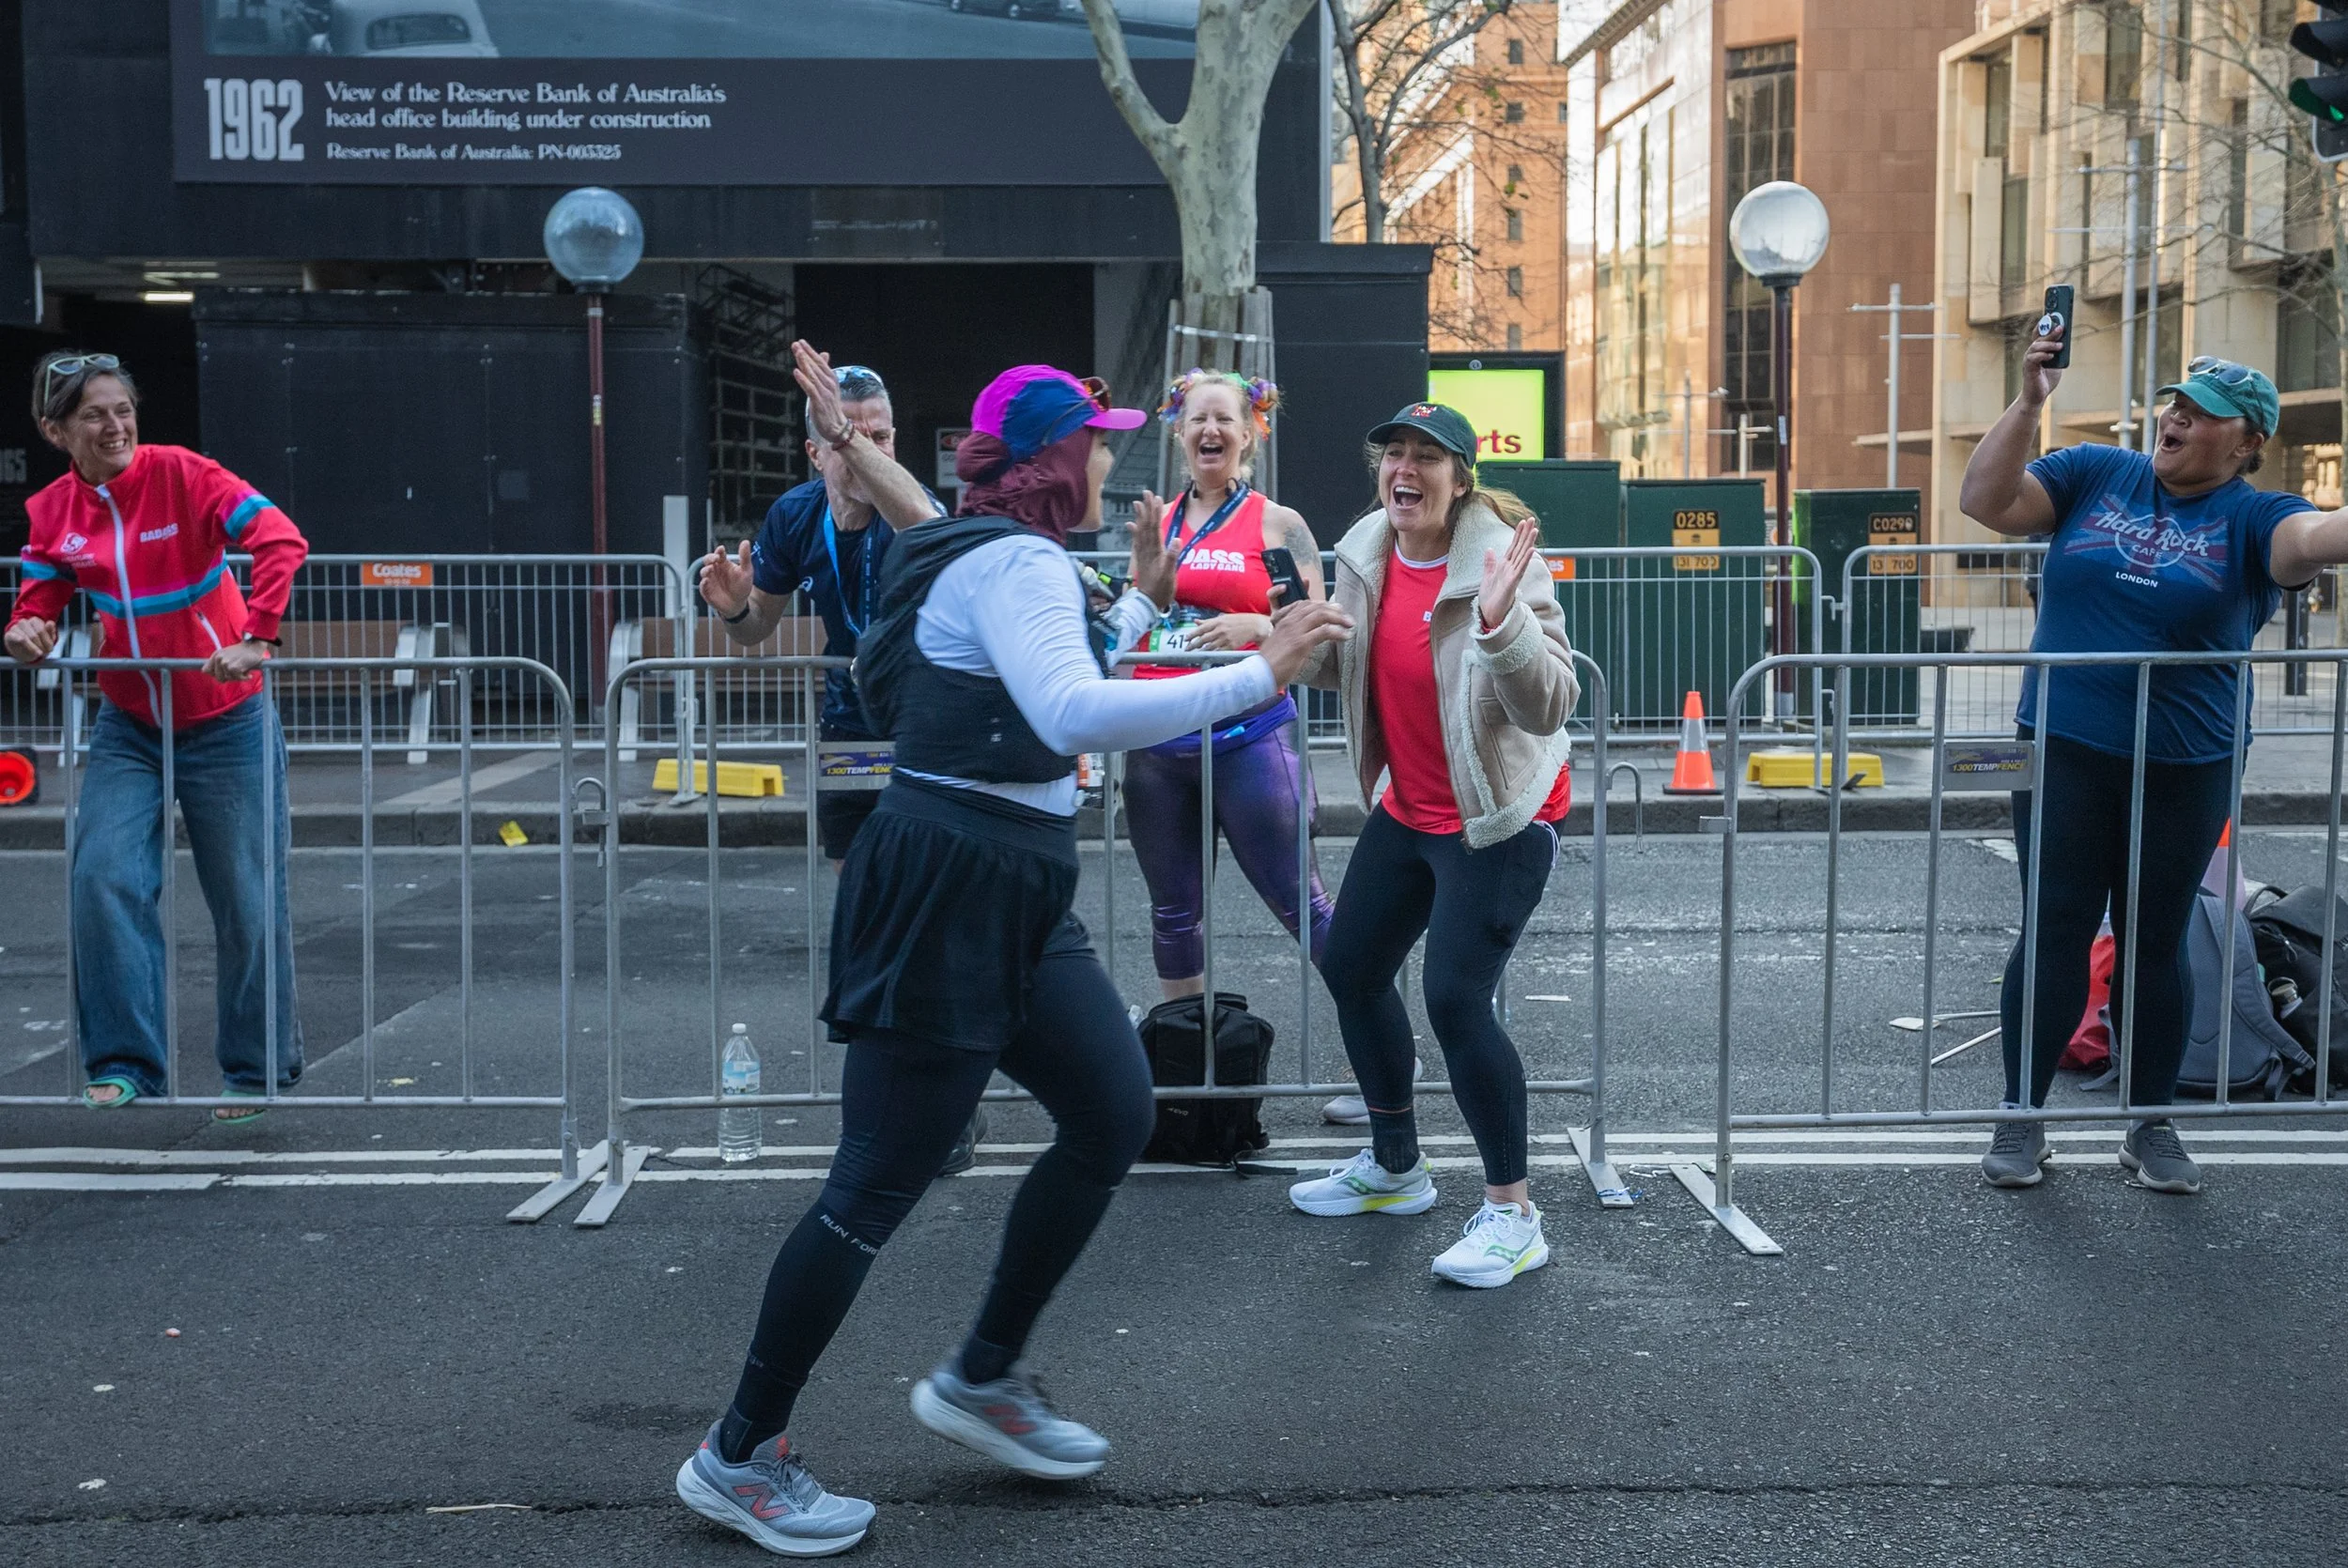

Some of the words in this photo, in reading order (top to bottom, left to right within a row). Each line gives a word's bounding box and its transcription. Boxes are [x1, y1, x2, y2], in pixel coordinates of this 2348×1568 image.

[324, 81, 376, 102] View
[381, 82, 403, 103] of
[408, 82, 440, 103] the
[447, 82, 531, 104] Reserve
[536, 83, 592, 103] Bank
[596, 83, 619, 103] of
[623, 83, 727, 104] Australia's
[204, 78, 304, 161] 1962
[326, 106, 376, 128] head
[381, 107, 436, 128] office
[441, 108, 521, 131] building
[526, 109, 584, 129] under
[589, 110, 712, 129] construction
[327, 142, 391, 160] Reserve
[394, 143, 438, 160] Bank
[440, 144, 458, 160] of
[1476, 429, 1522, 453] rts
[1676, 512, 1717, 529] 0285
[2094, 510, 2155, 542] Hard
[2156, 528, 2210, 557] Rock
[1182, 548, 1245, 564] DASS
[2131, 543, 2163, 559] CAFE
[372, 562, 422, 578] Coates
[1190, 562, 1217, 571] LADY
[1217, 563, 1245, 573] GANG
[2115, 571, 2158, 588] LONDON
[1166, 634, 1185, 650] 41
[820, 1214, 849, 1238] RUN
[850, 1237, 879, 1255] FOR
